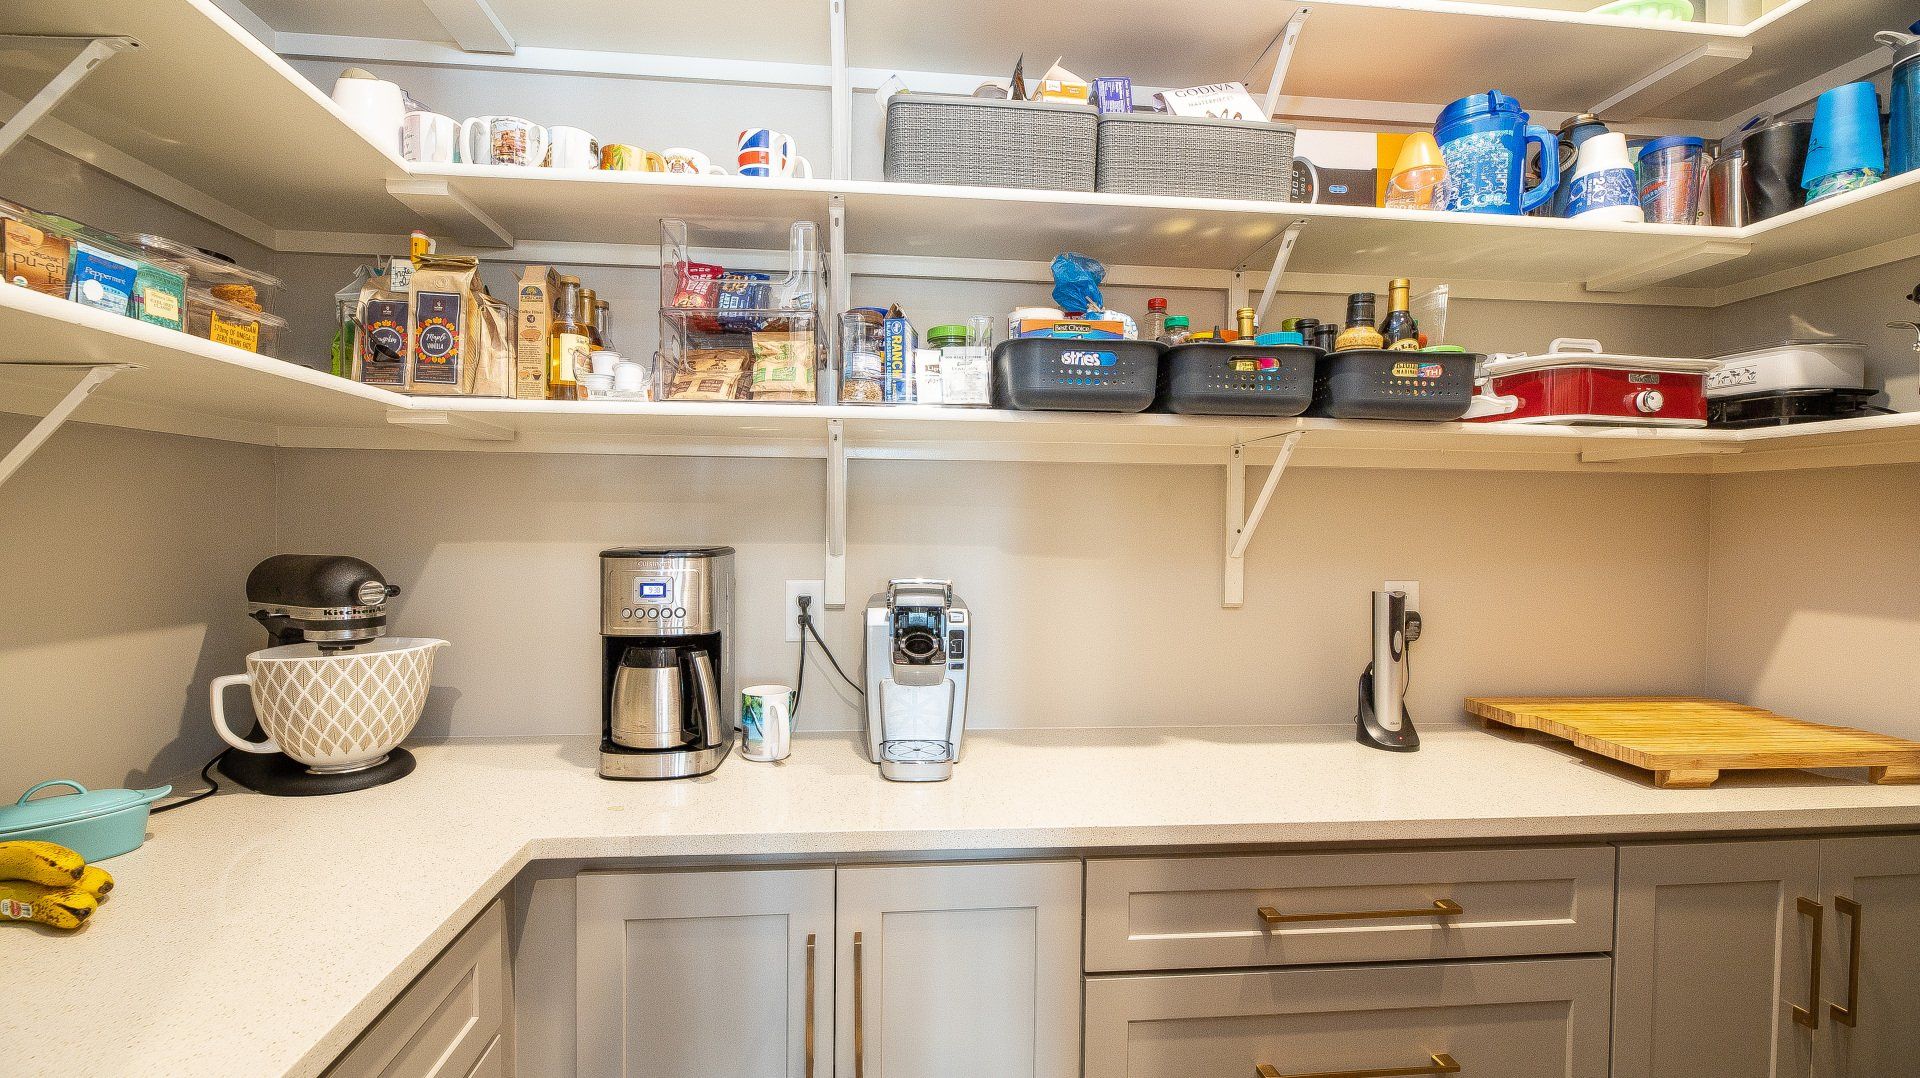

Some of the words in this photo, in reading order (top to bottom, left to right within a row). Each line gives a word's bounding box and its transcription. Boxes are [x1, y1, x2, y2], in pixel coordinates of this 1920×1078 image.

[1174, 83, 1234, 98] GODIVA
[84, 266, 126, 284] Peppermint
[1054, 324, 1068, 332] Best
[1068, 324, 1091, 333] Choice
[427, 332, 447, 343] Maple
[892, 335, 903, 379] RANCH
